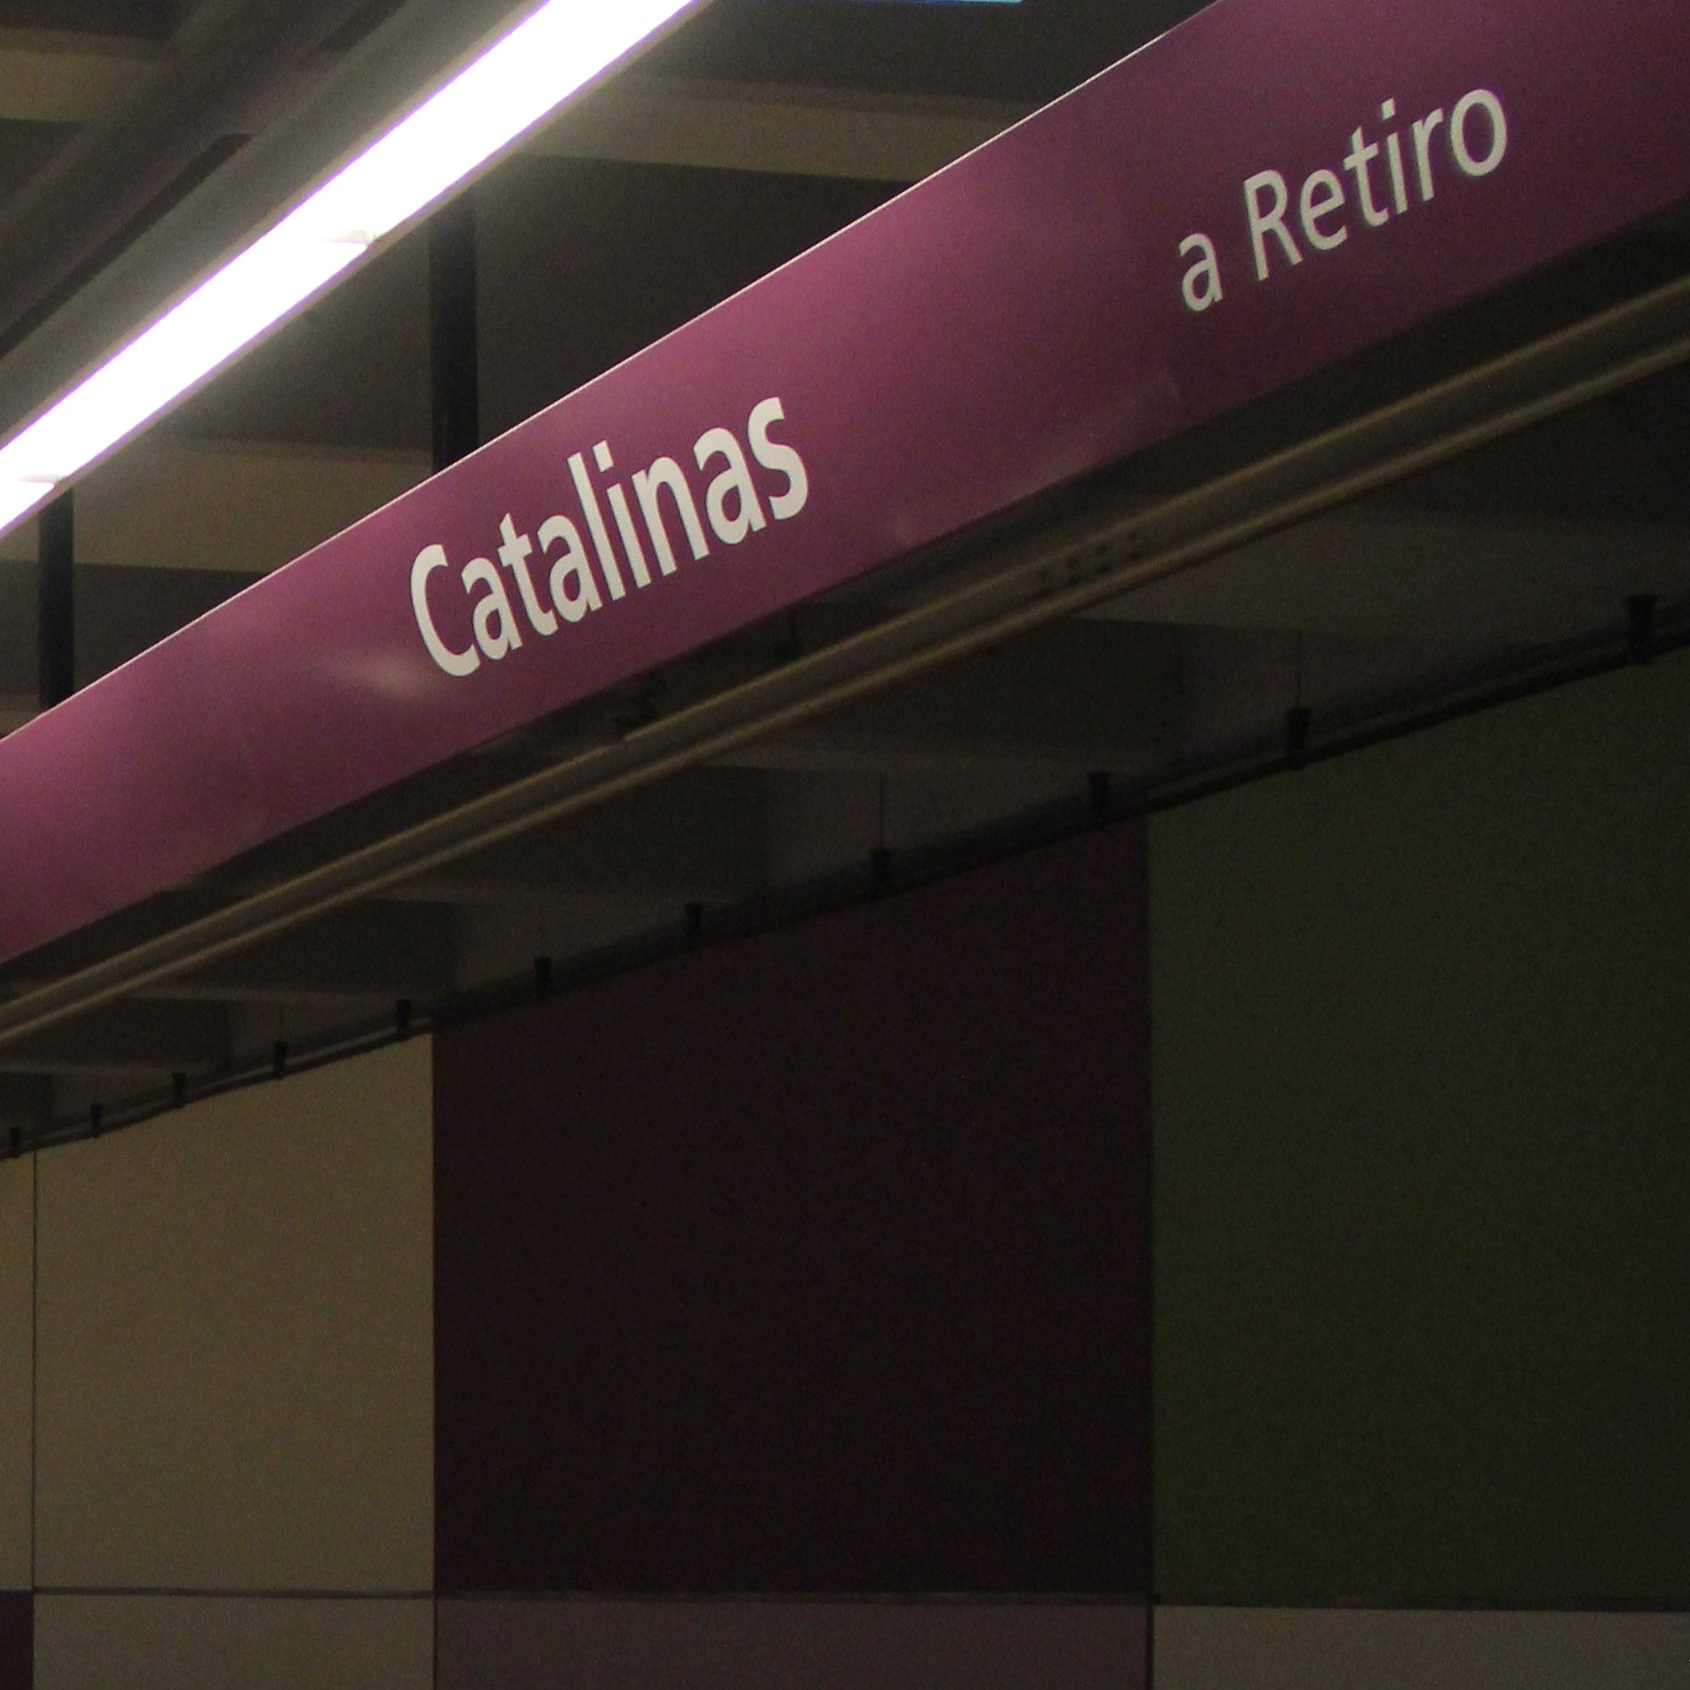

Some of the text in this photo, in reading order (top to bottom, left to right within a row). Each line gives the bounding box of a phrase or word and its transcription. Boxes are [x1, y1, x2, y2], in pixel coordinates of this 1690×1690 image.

[1178, 88, 1508, 312] a Retiro
[410, 396, 810, 678] Catalinas
